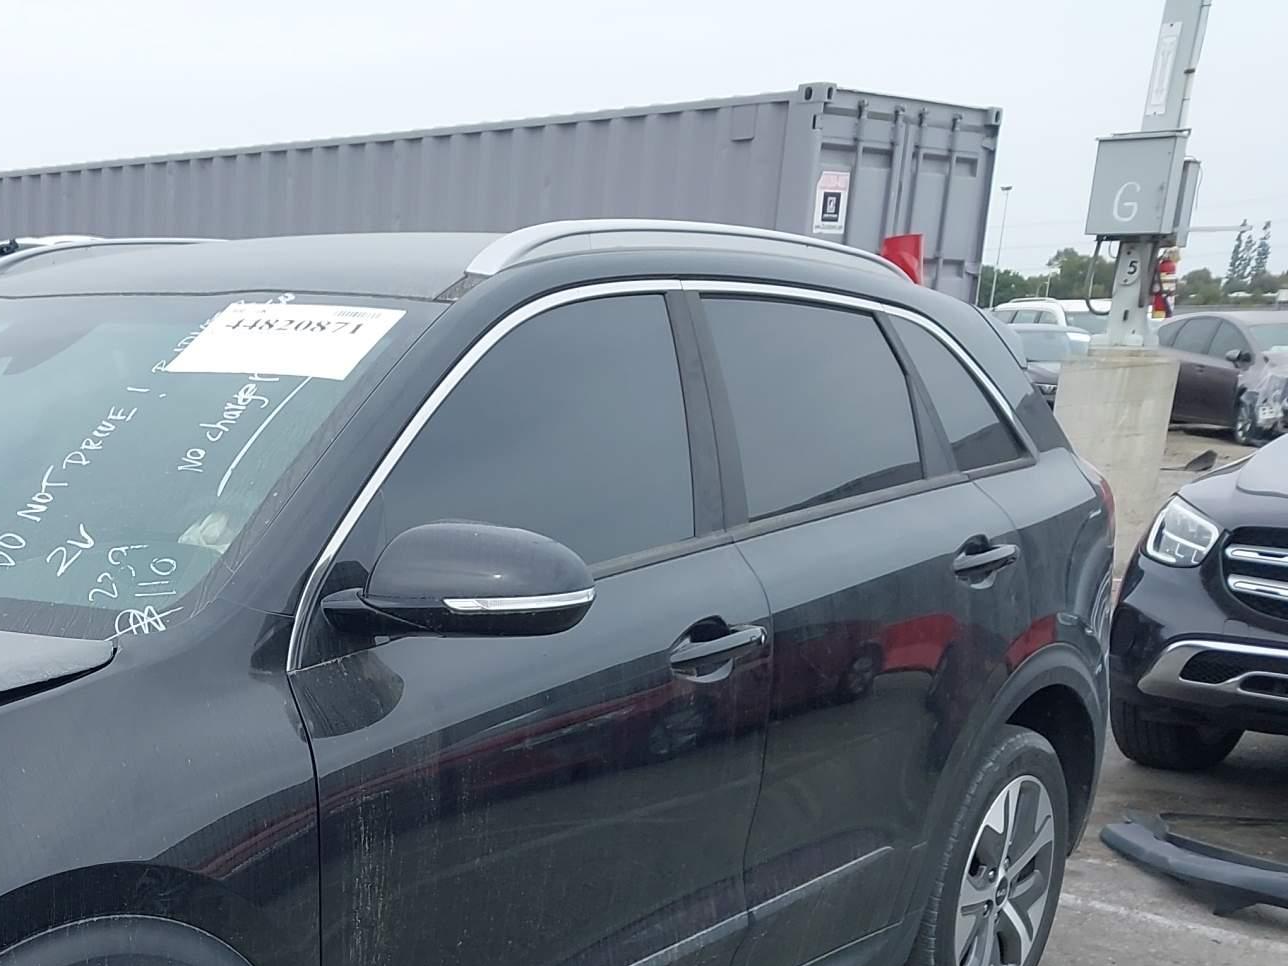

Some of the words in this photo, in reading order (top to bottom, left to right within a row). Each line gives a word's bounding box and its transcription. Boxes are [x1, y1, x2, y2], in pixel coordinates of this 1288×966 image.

[1113, 181, 1141, 222] G
[1127, 260, 1139, 275] 5
[225, 318, 364, 335] 44820871
[17, 465, 69, 522] NOT
[63, 406, 138, 469] DRIVE
